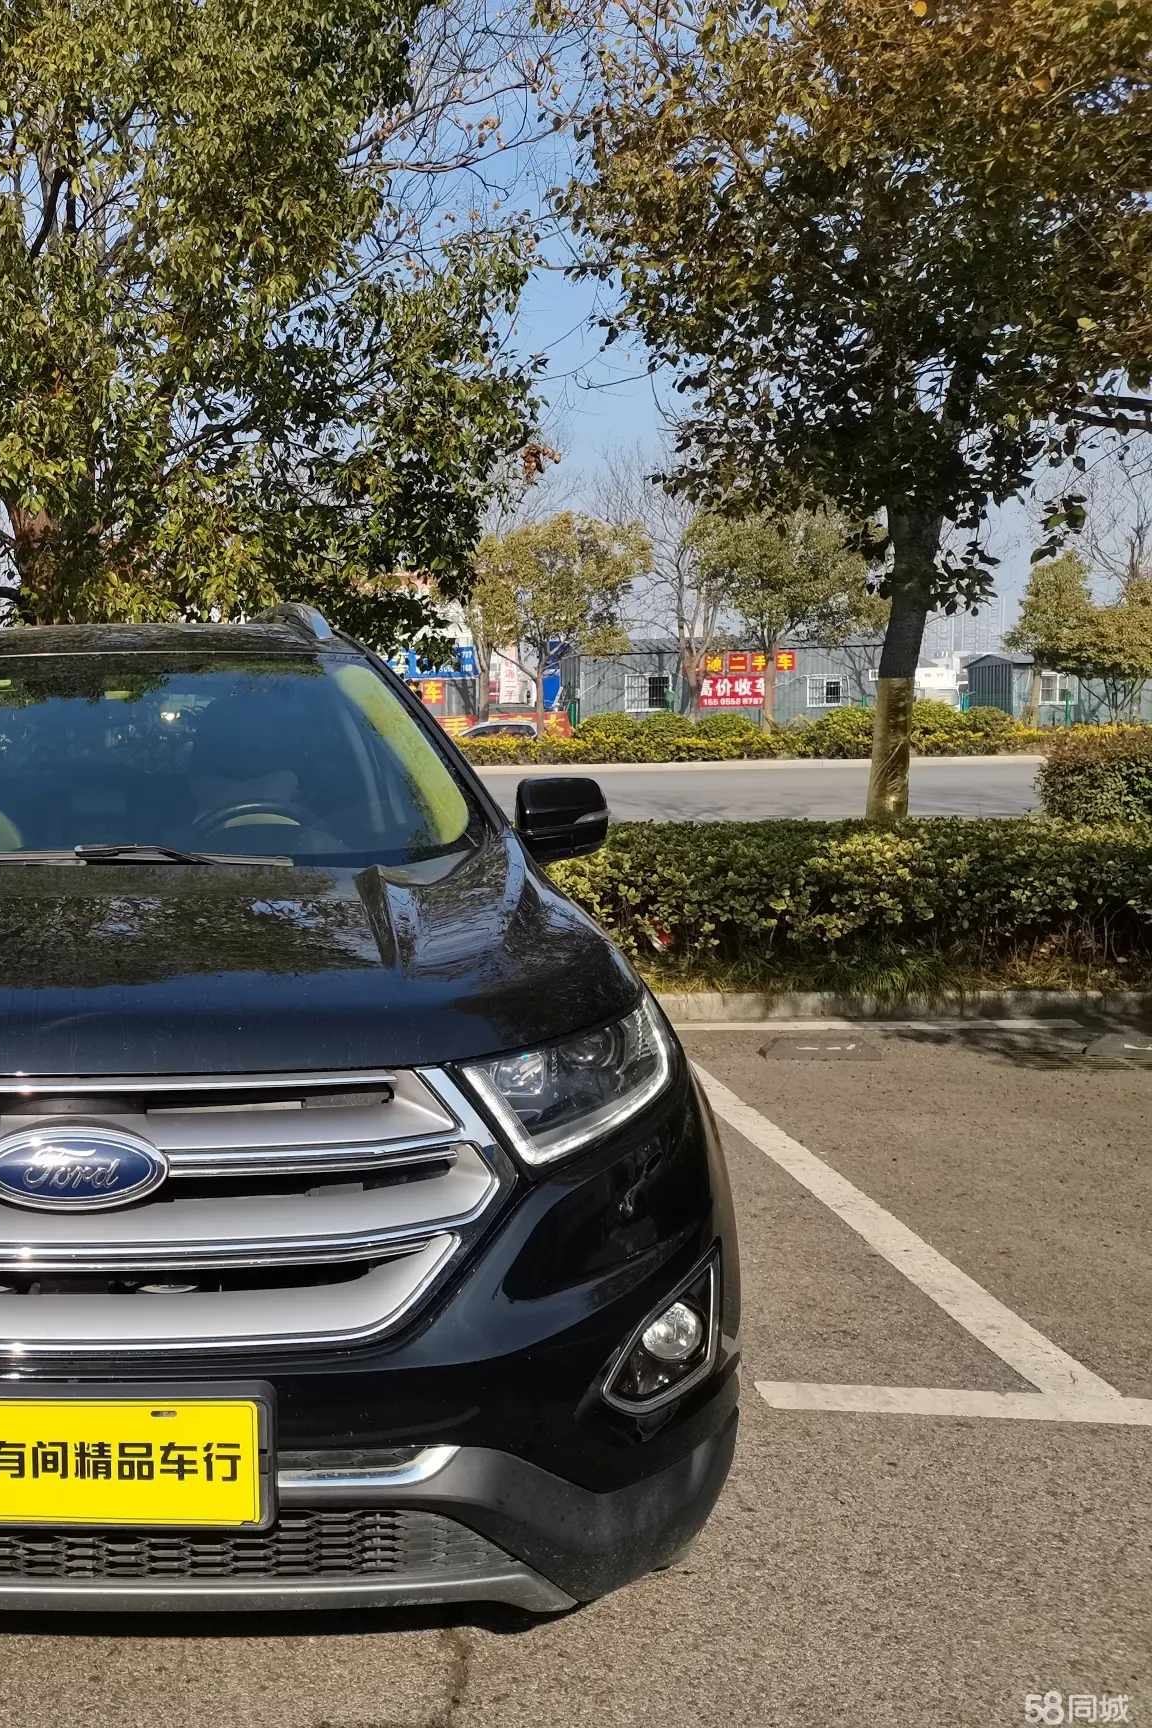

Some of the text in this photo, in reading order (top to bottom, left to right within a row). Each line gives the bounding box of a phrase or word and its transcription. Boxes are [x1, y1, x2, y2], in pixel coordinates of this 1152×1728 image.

[694, 653, 793, 672] 源二手车
[23, 1146, 120, 1189] Ford
